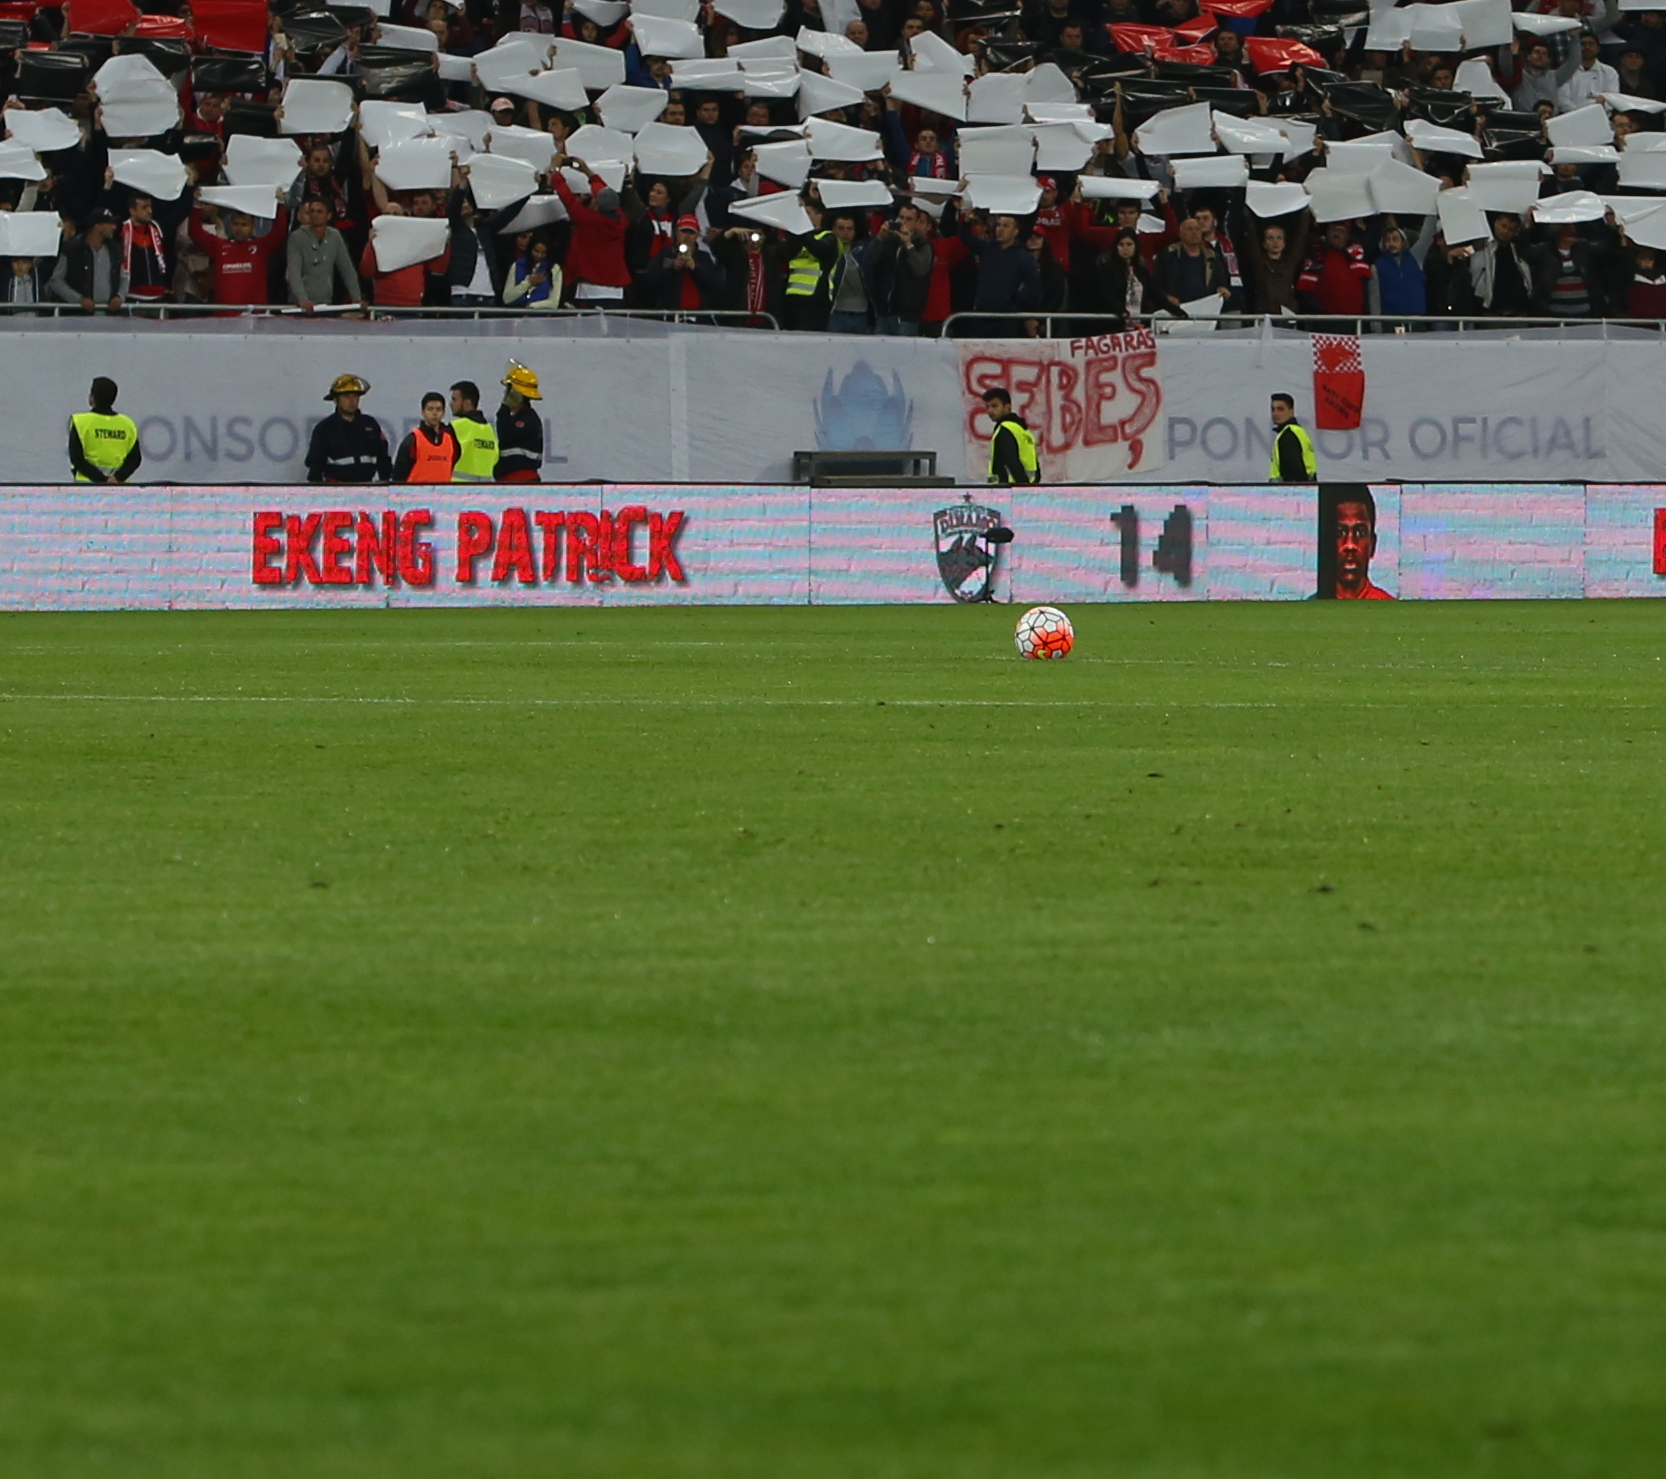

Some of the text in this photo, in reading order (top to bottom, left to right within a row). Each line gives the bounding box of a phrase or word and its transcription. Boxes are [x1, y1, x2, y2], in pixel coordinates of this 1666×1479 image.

[93, 427, 127, 441] STEWARD
[1409, 415, 1606, 461] OFICIAL
[250, 504, 687, 588] EKENG PATRICK
[1109, 504, 1196, 589] 14
